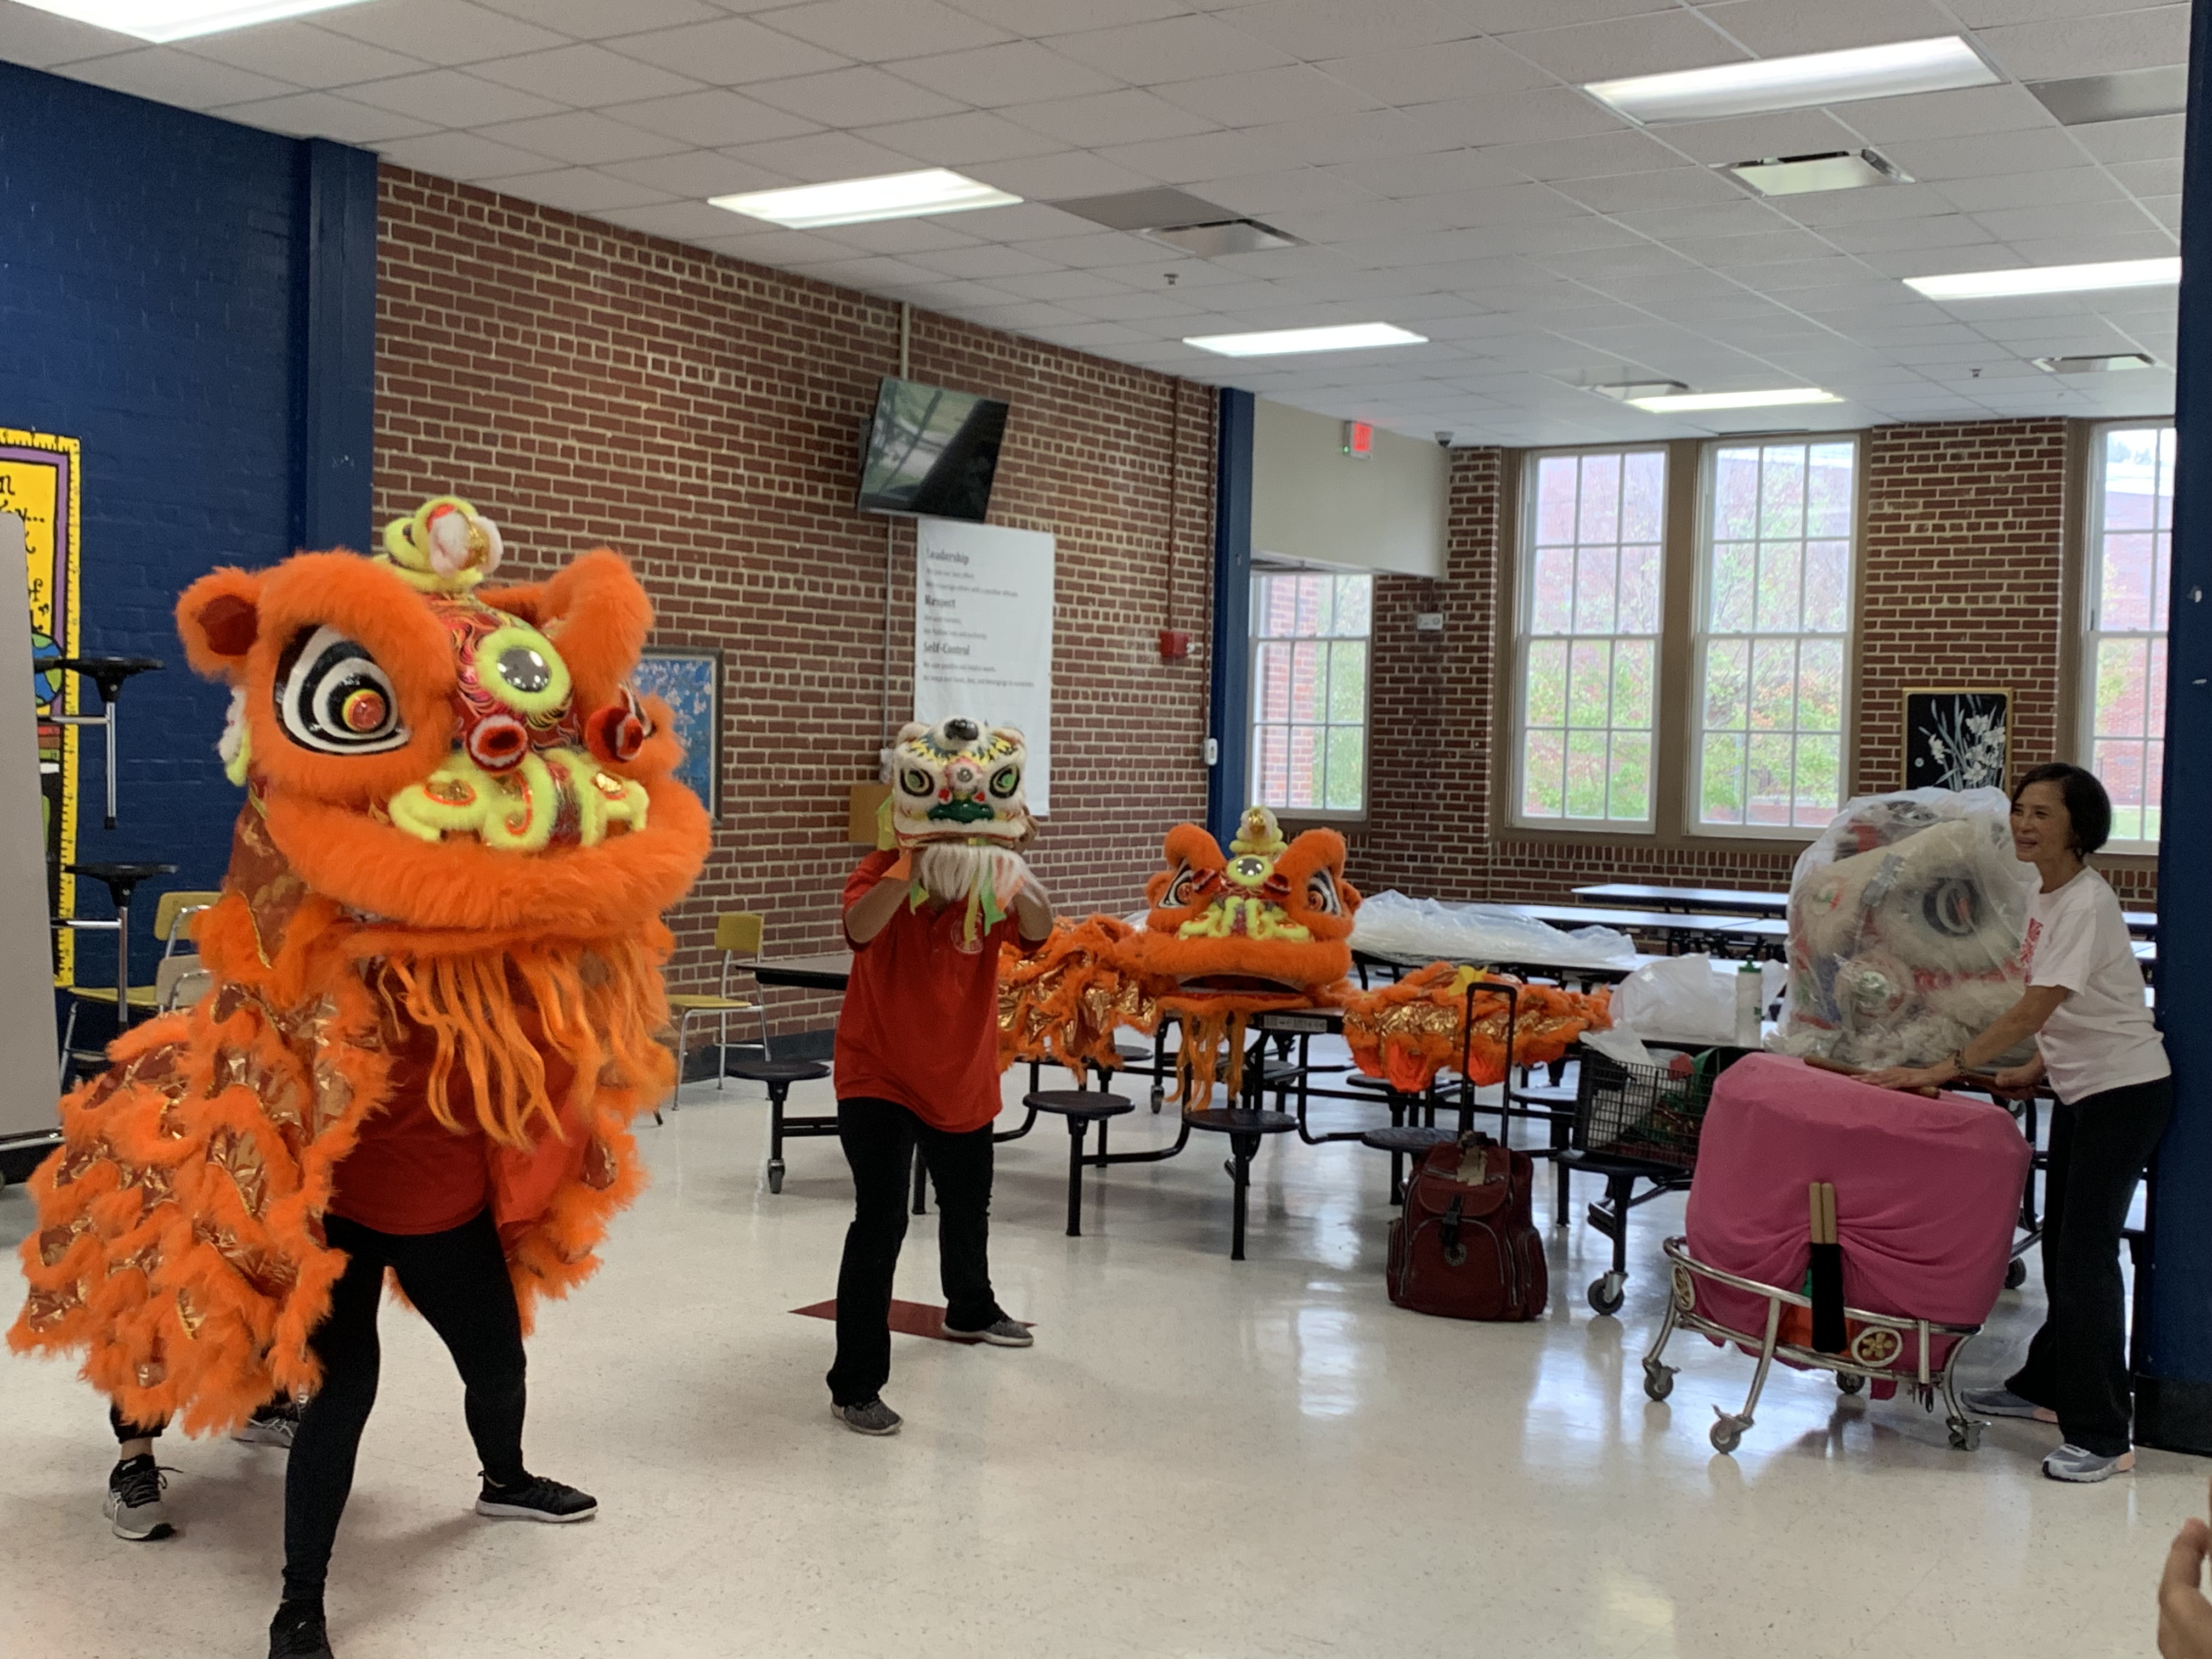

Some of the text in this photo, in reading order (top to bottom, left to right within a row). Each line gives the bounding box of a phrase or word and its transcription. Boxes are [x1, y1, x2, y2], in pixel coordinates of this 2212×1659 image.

[926, 547, 969, 566] Leadership
[925, 594, 956, 608] Respect
[924, 641, 970, 656] Self-Control
